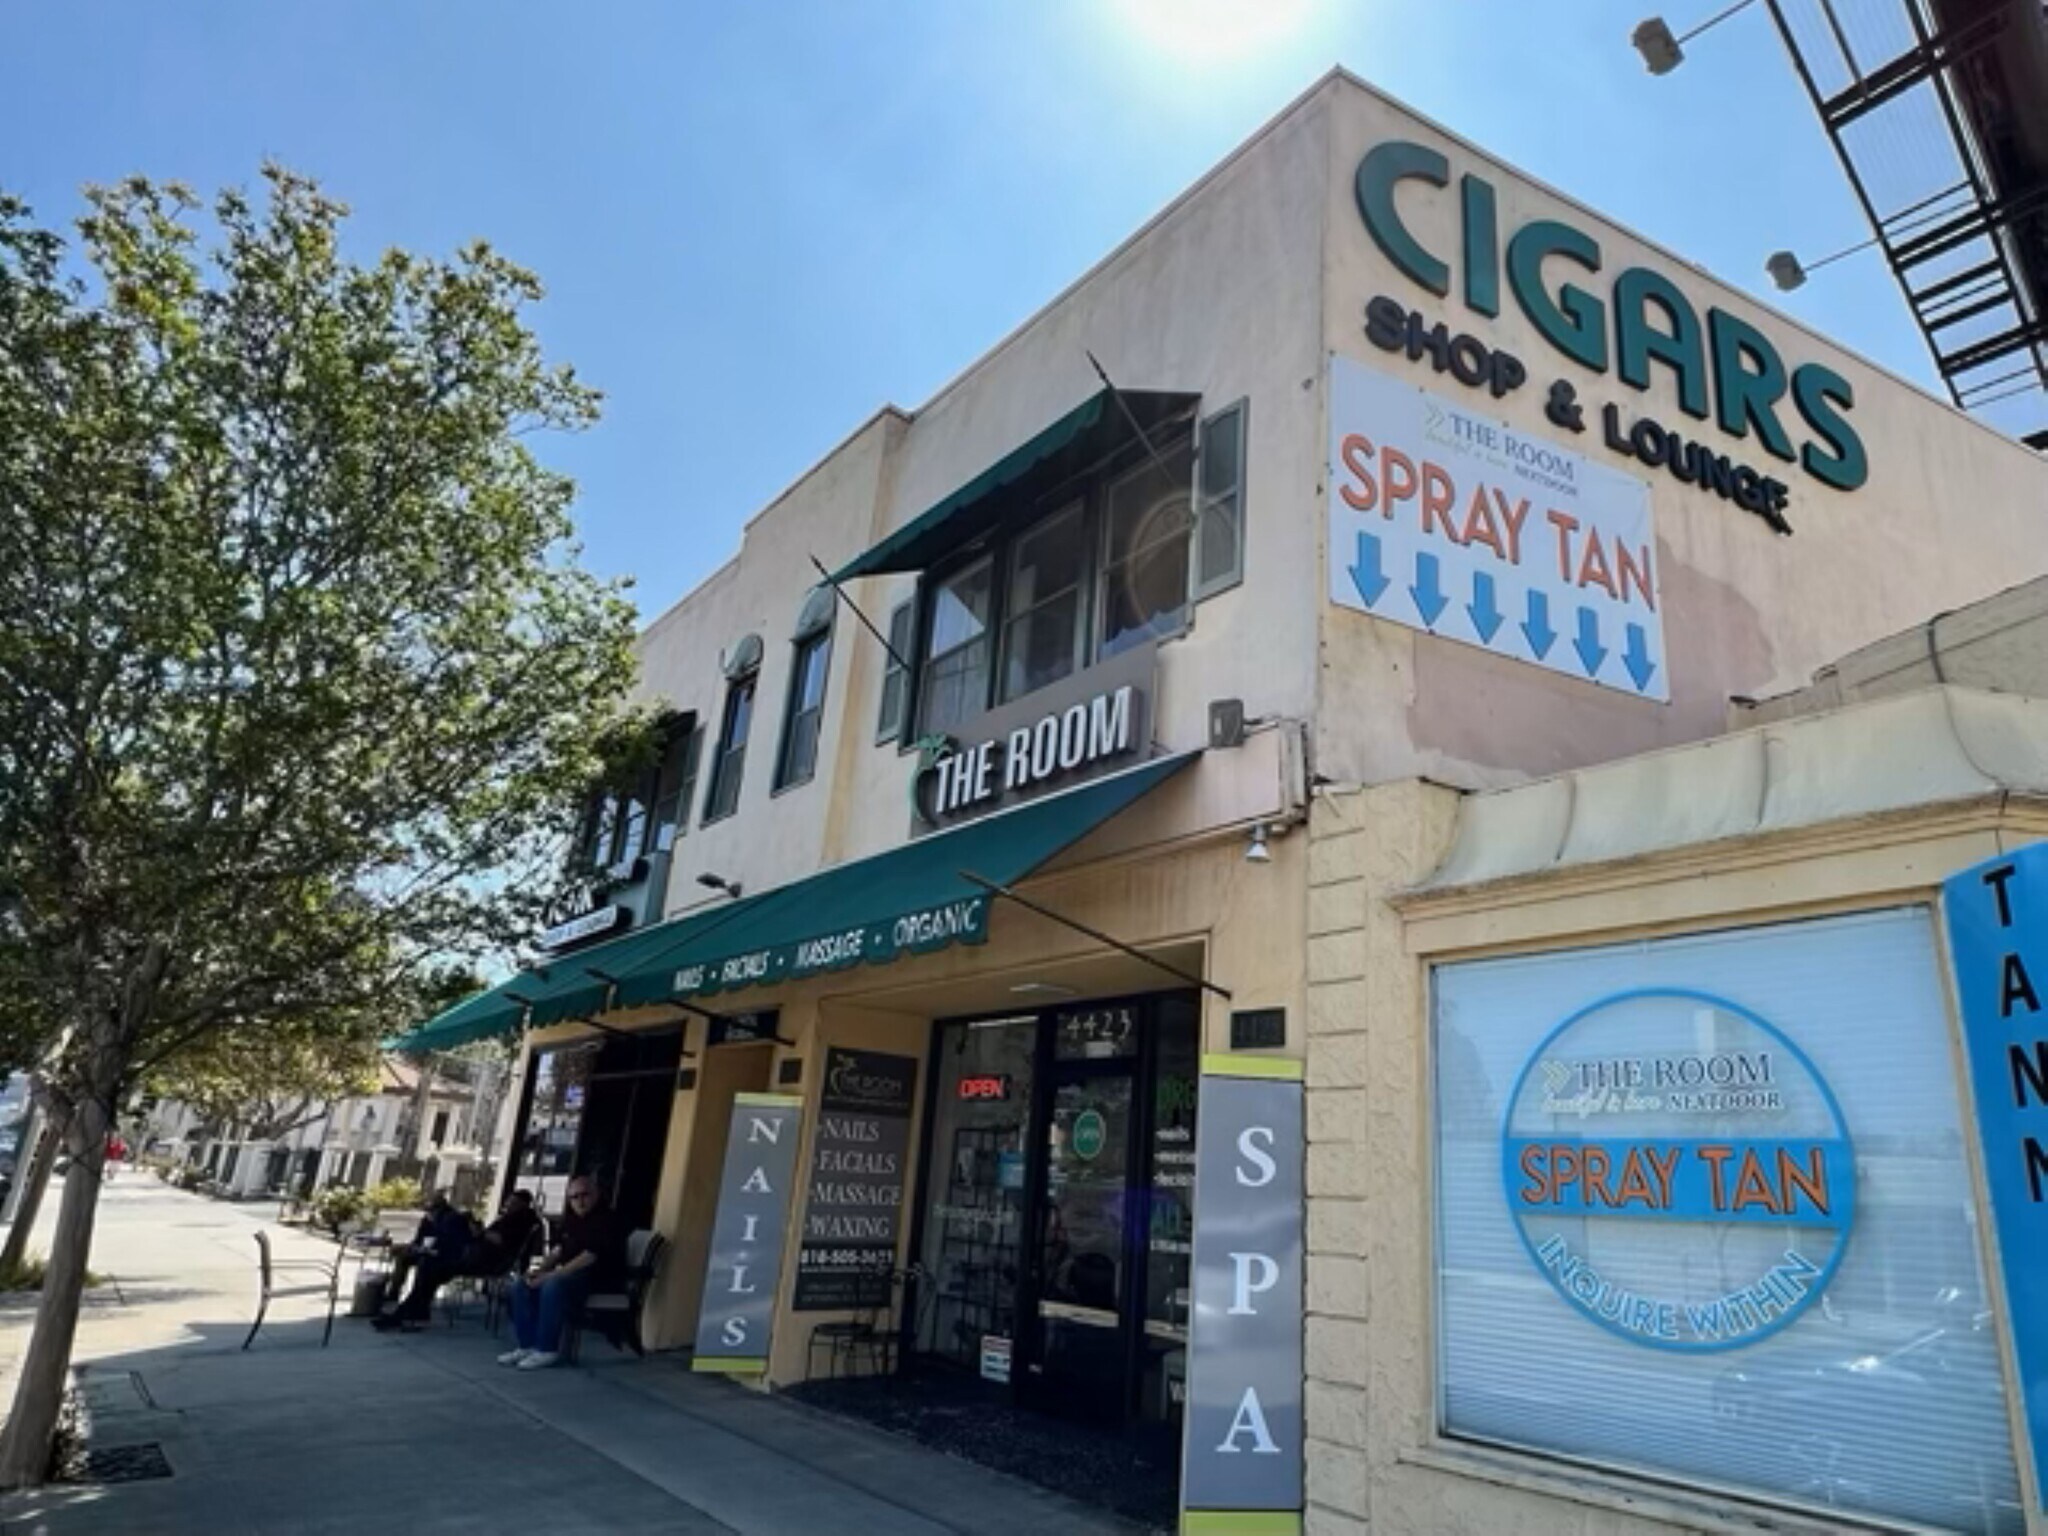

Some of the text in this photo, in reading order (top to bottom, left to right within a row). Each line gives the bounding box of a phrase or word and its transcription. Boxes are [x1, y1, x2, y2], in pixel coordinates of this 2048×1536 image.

[1354, 140, 1868, 491] CIGARS
[1364, 295, 1793, 536] SHOP & LOUNGE
[1449, 412, 1500, 451] THE
[1504, 433, 1575, 482] ROOM
[1339, 433, 1656, 614] SPRAY TAN
[935, 685, 1133, 813] THE ROOM
[795, 929, 865, 969] MASSAGE
[892, 899, 982, 947] ORGANIC
[1066, 1009, 1132, 1040] 4423
[958, 1077, 1005, 1100] OPEN
[1575, 1051, 1774, 1090] THE ROOM
[818, 1150, 897, 1175] FACIALS
[822, 1118, 880, 1142] NAILS
[814, 1182, 901, 1206] MASSAGE
[1519, 1144, 1831, 1217] SPRAY TAN
[722, 1117, 783, 1347] NAILS
[811, 1216, 891, 1240] WAXING
[1215, 1125, 1282, 1455] SPA
[1538, 1233, 1823, 1341] INQUIRE WITHIN
